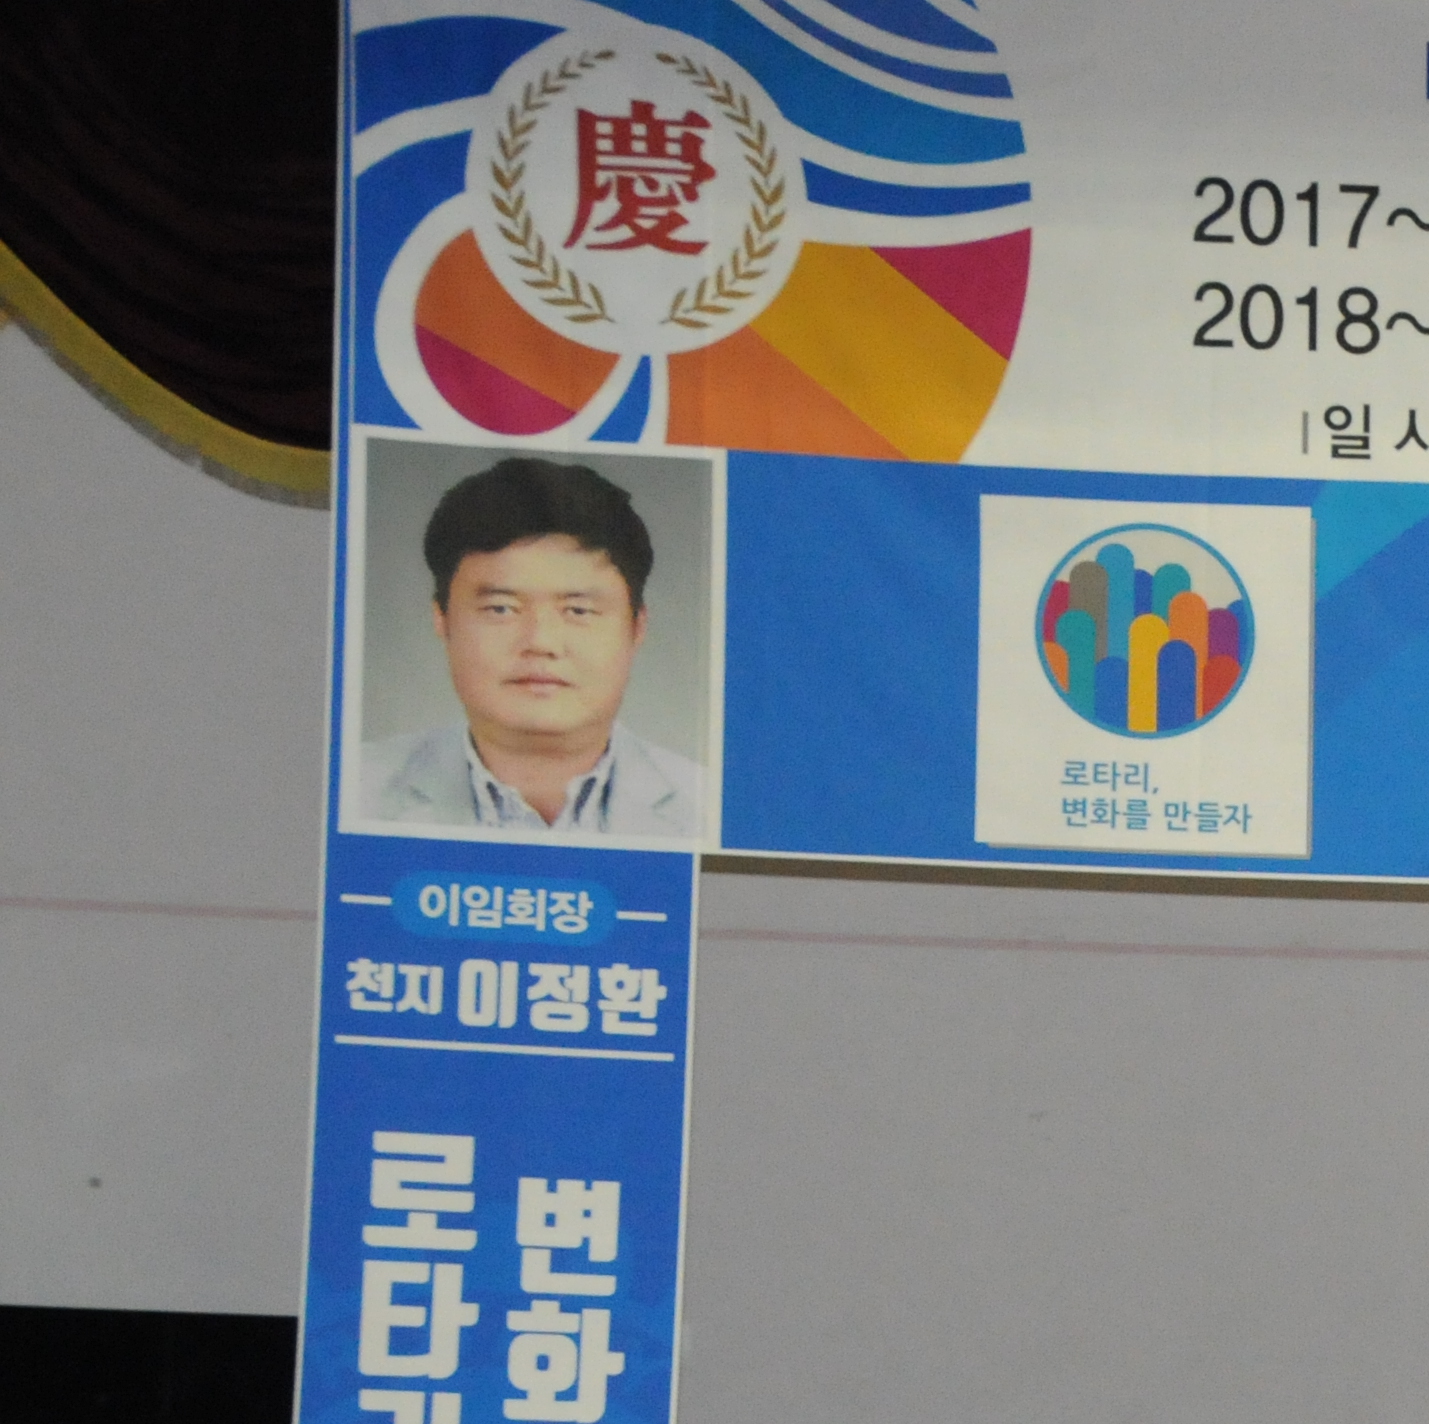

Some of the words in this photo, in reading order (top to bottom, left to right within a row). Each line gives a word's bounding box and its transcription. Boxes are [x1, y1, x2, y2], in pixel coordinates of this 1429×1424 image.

[563, 100, 716, 256] 慶
[1061, 761, 1159, 794] 로타리,
[1061, 797, 1152, 831] 변화를
[1163, 801, 1253, 834] 만들자
[418, 882, 594, 934] 이임회장
[346, 958, 444, 1016] 천지
[457, 959, 668, 1037] 이정환
